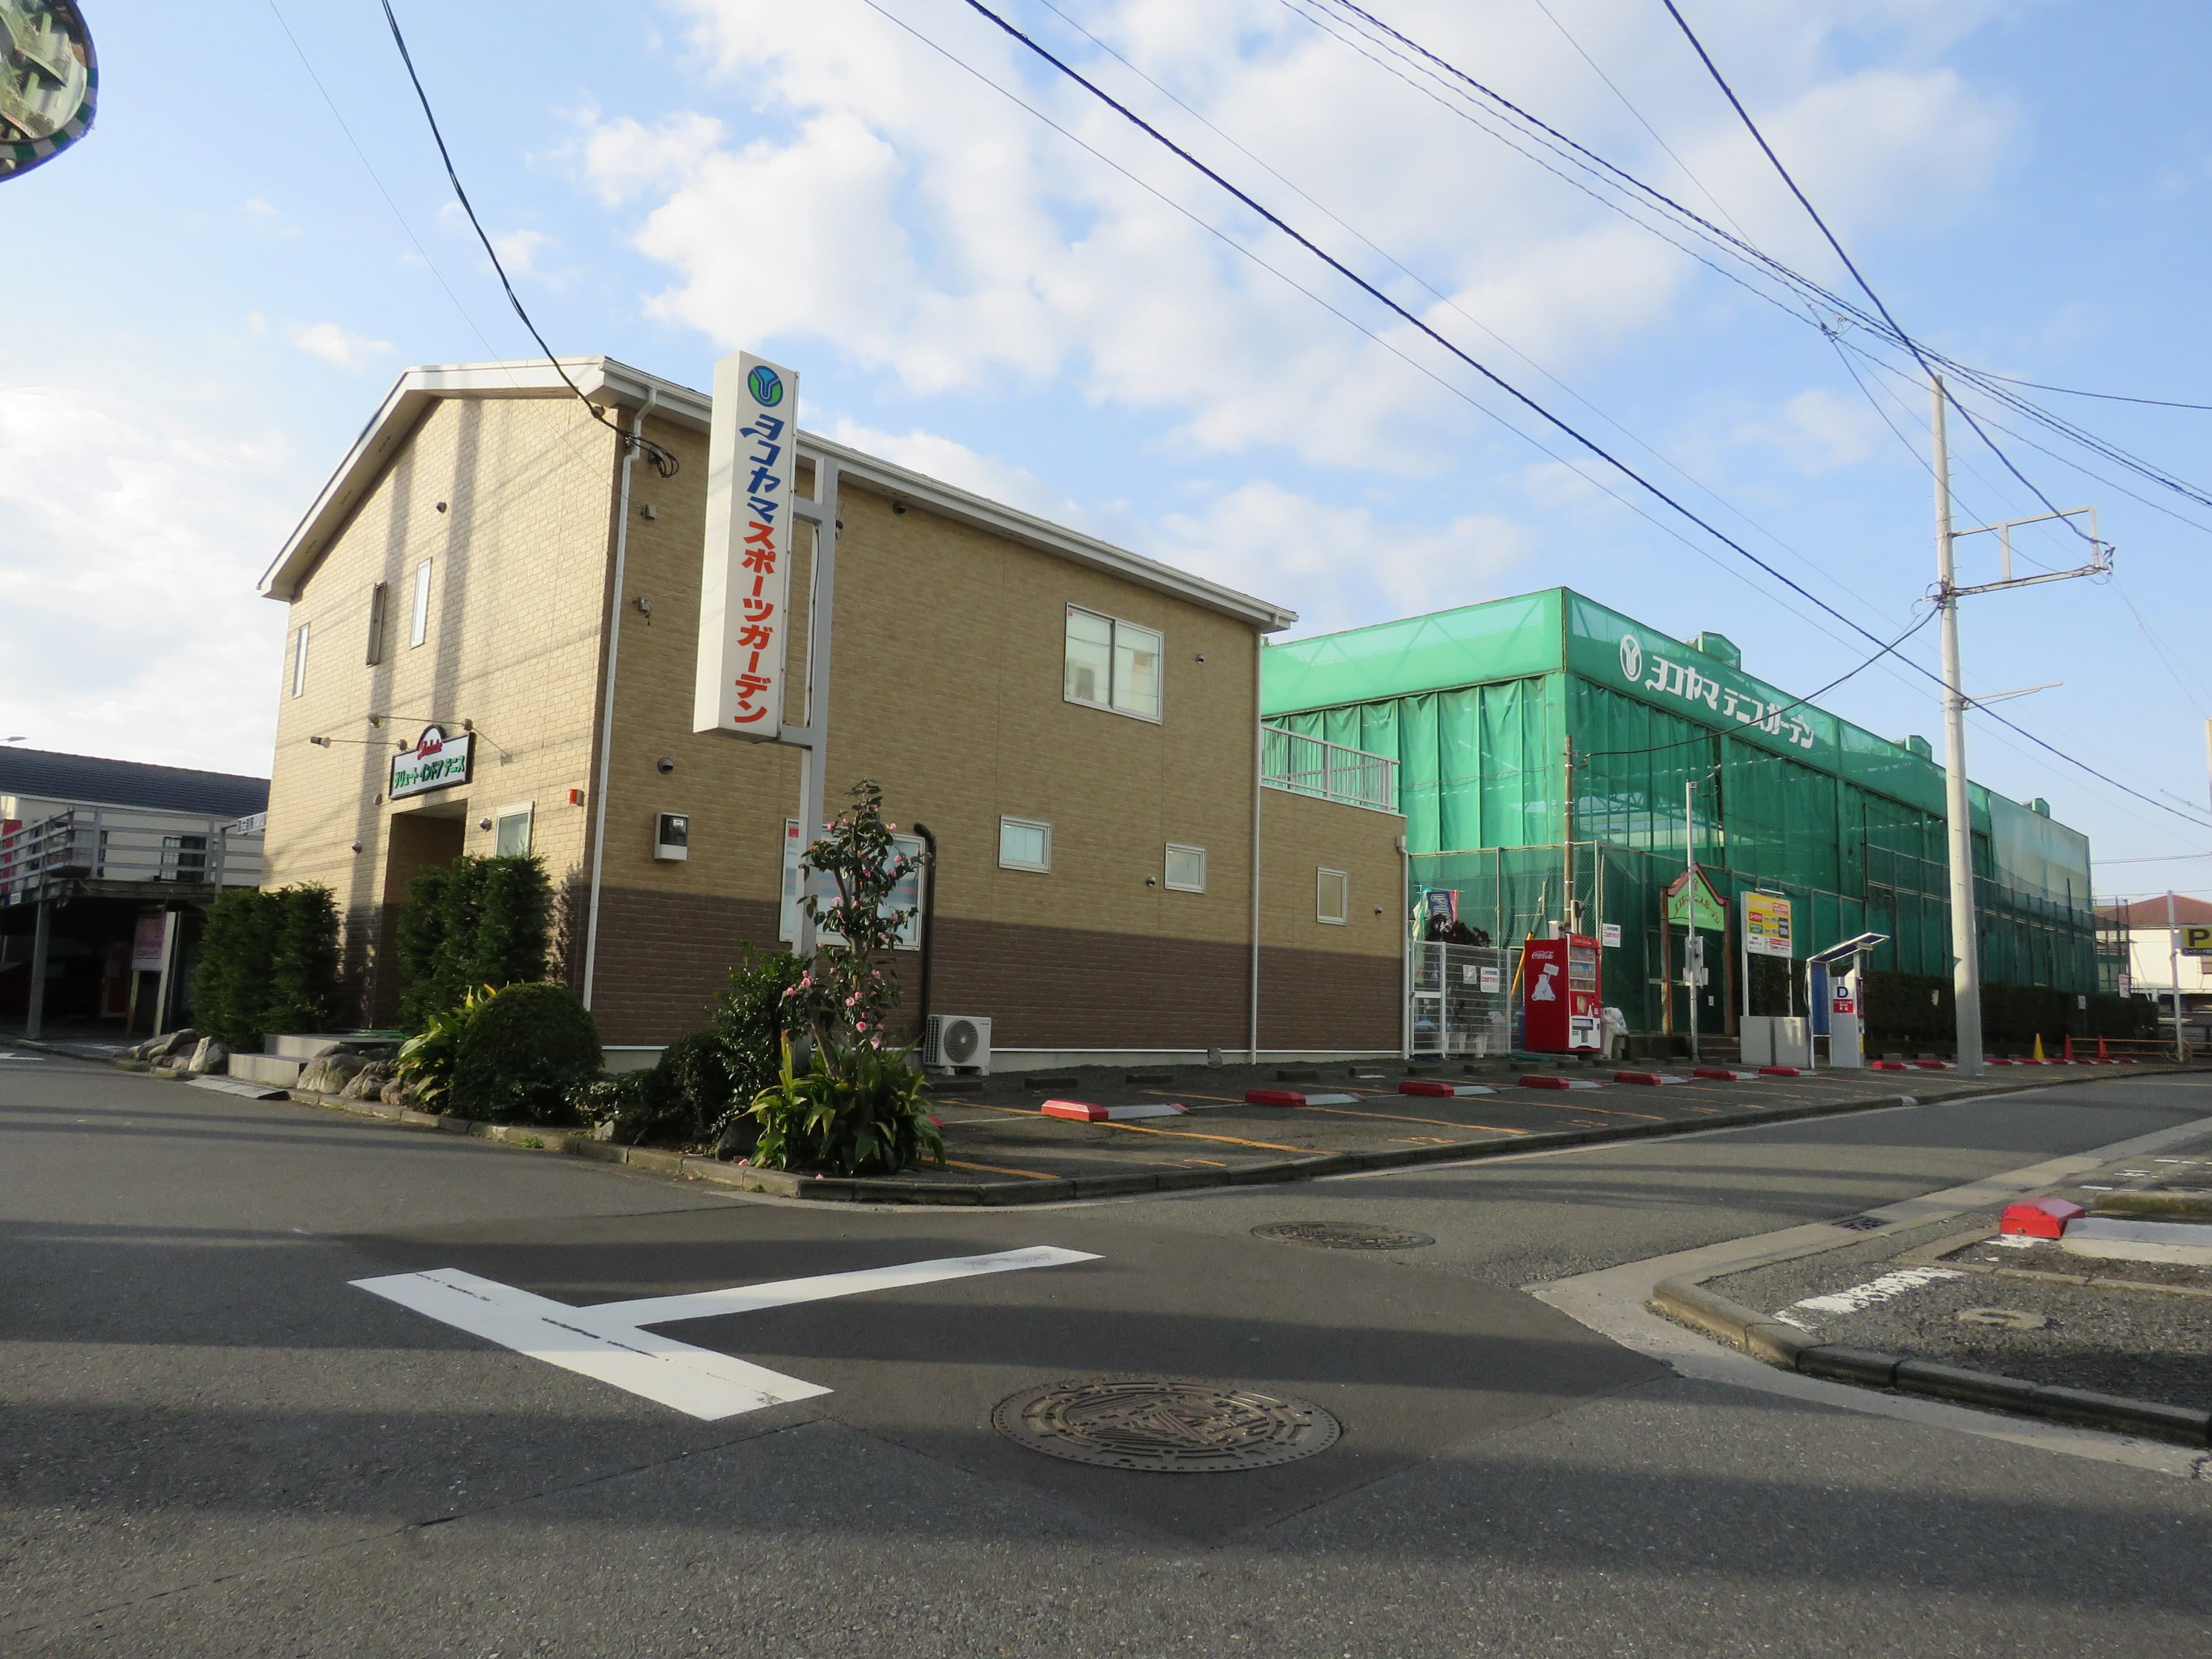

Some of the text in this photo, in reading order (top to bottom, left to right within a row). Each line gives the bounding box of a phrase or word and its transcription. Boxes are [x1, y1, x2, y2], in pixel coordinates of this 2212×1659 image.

[734, 413, 785, 723] ヨコヤマスポーツガーデン
[2188, 929, 2210, 946] P
[1837, 986, 1849, 998] D
